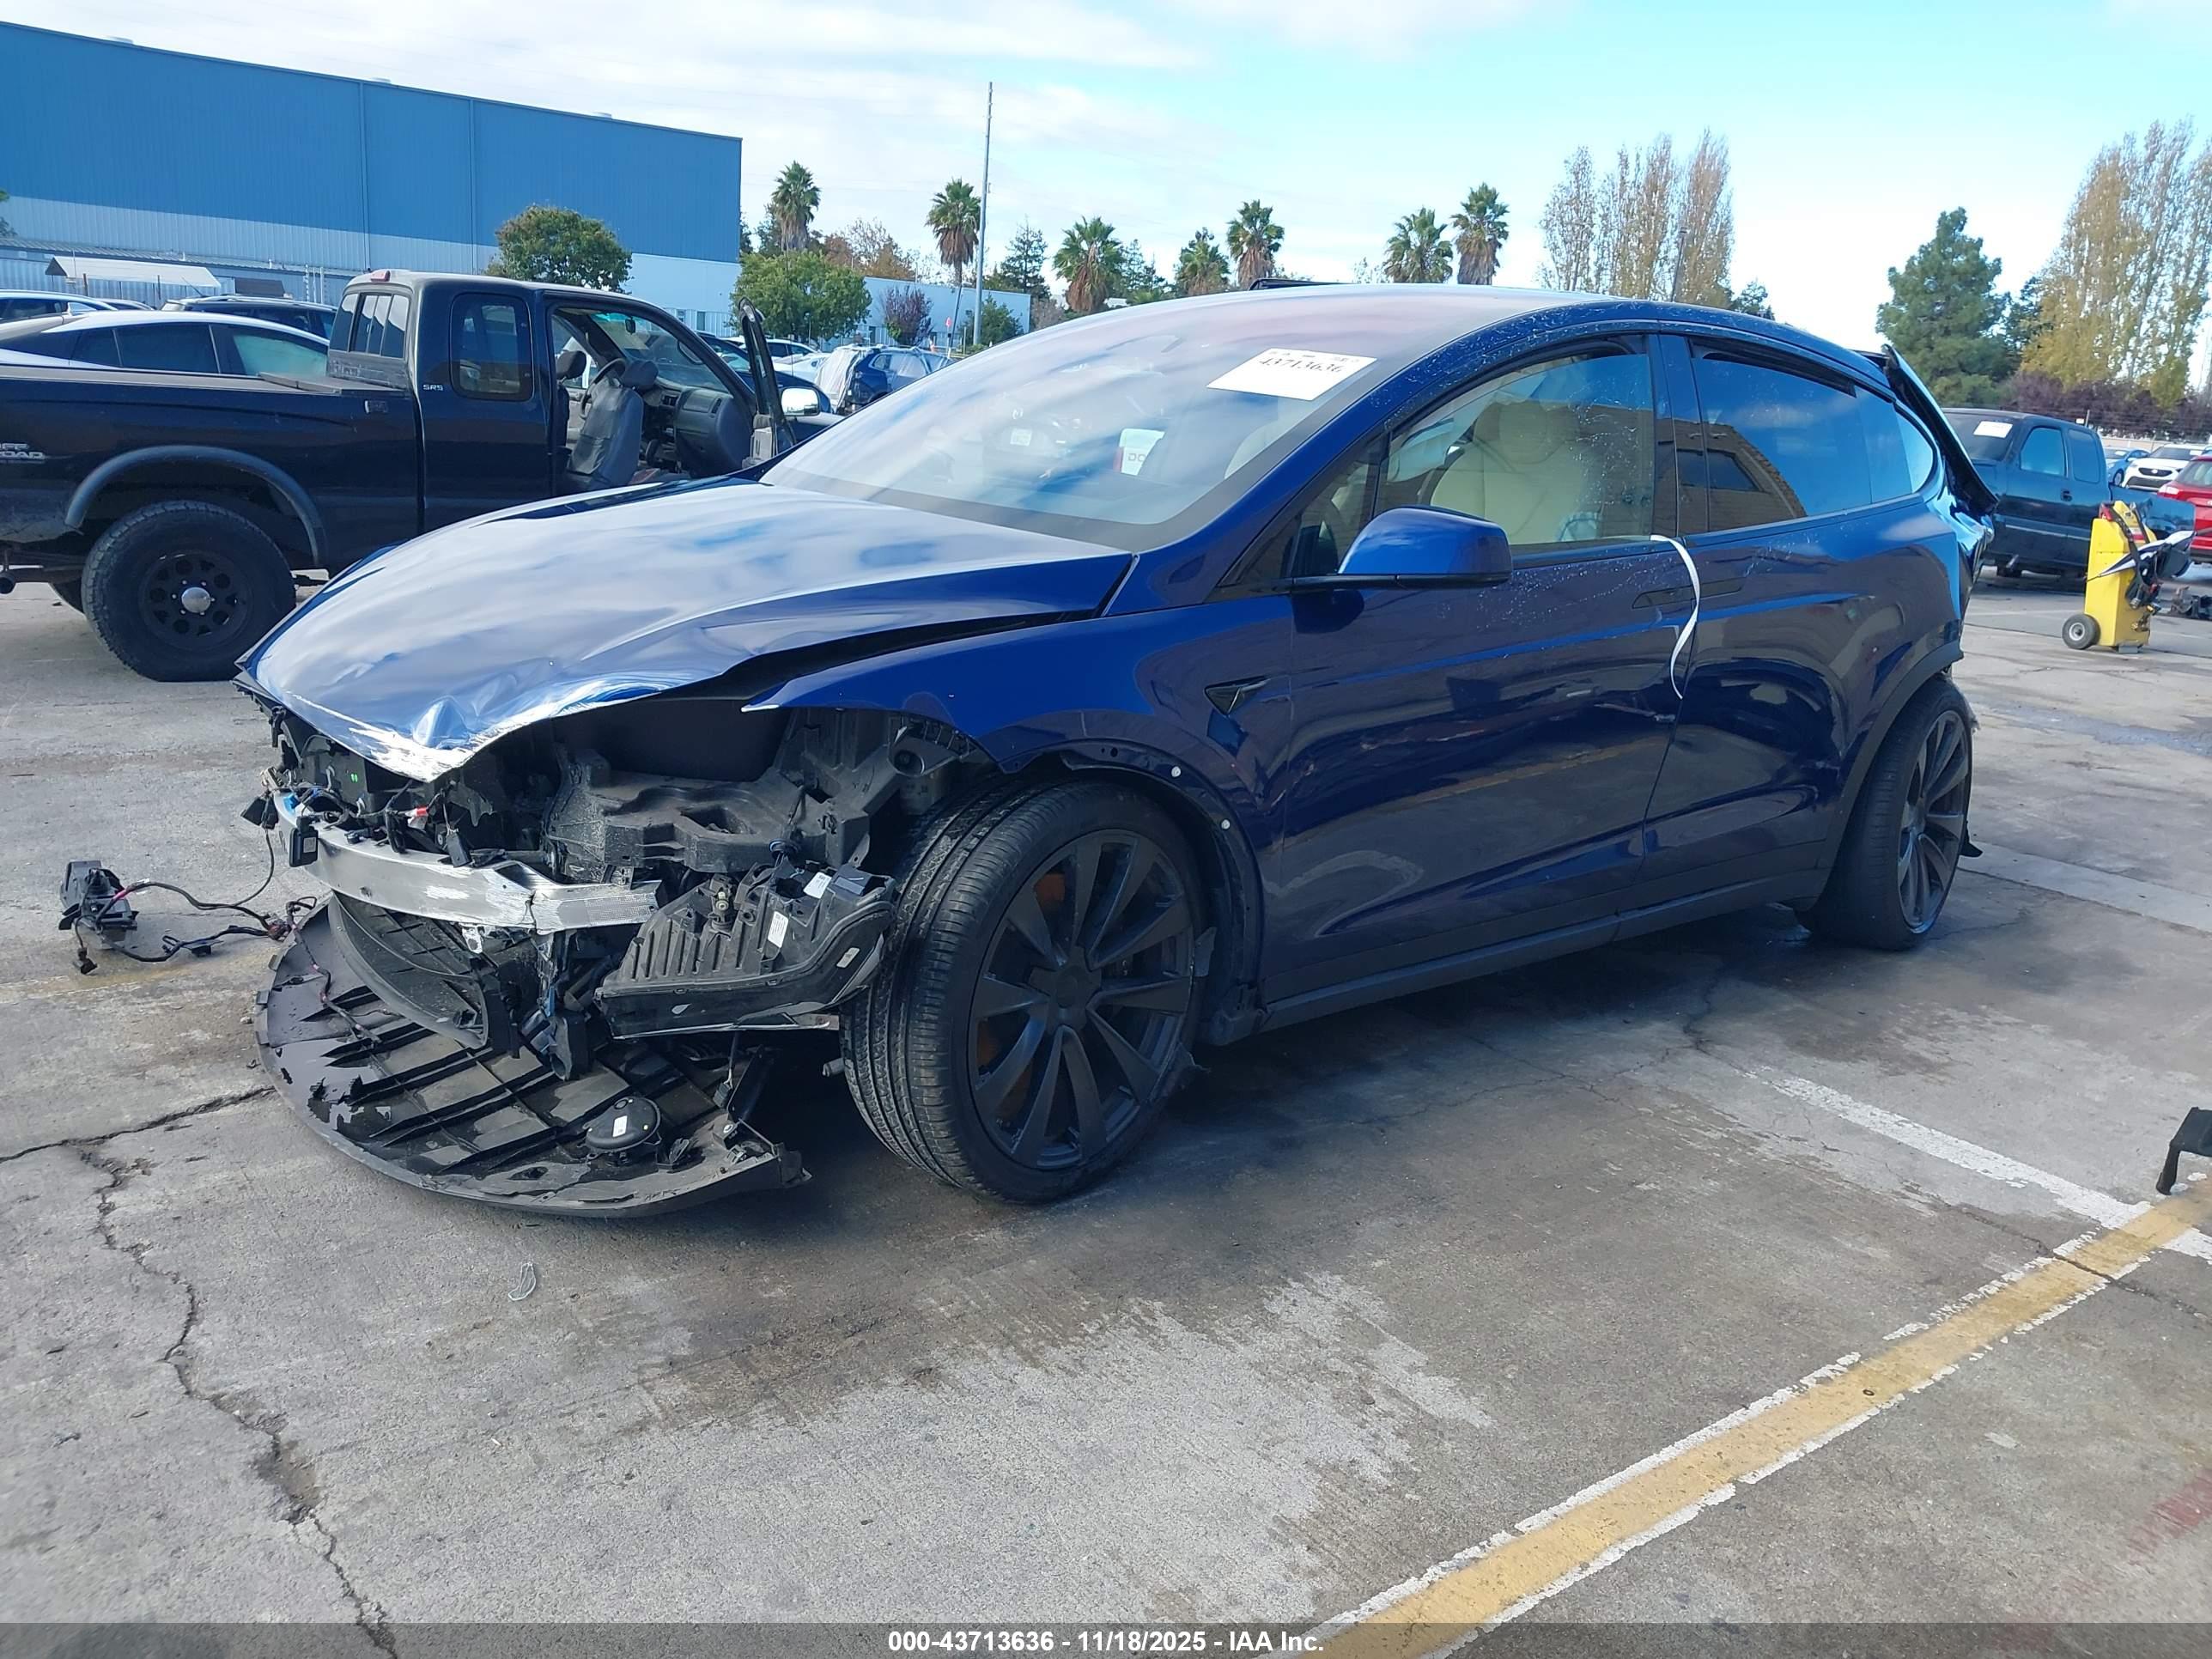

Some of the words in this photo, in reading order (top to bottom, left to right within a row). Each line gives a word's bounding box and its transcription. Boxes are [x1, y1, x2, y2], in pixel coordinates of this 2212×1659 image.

[1259, 357, 1345, 373] 43713636
[0, 442, 28, 451] FF
[0, 451, 46, 459] OAD
